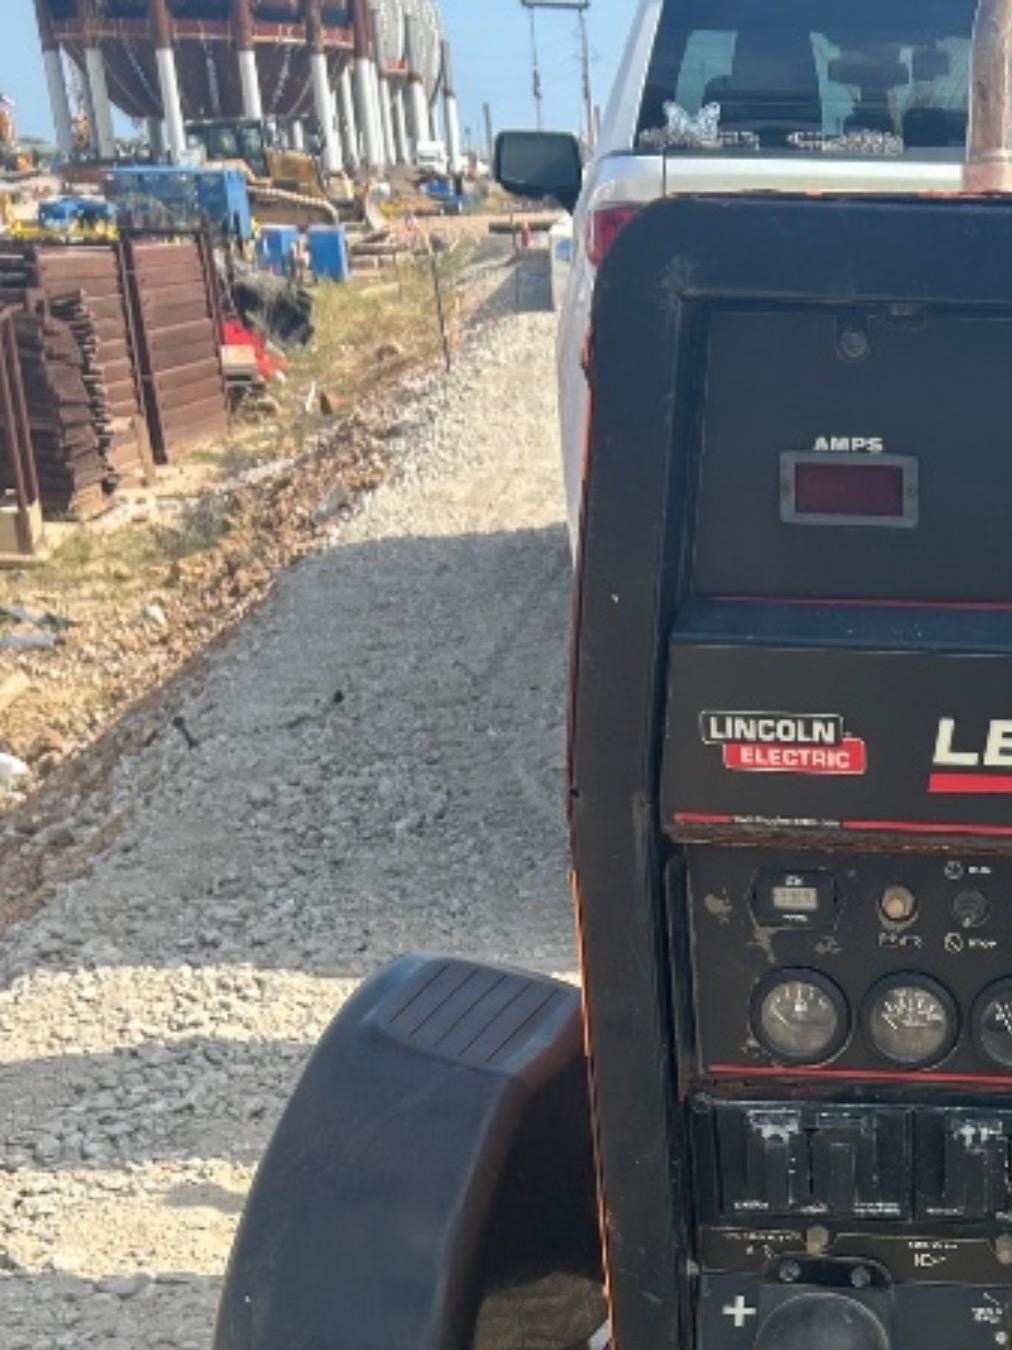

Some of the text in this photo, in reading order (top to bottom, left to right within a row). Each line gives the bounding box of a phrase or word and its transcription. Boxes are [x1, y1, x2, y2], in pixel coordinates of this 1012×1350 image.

[813, 436, 884, 454] AMPS
[710, 717, 834, 743] LINCOLN
[740, 748, 850, 769] ELECTRIC
